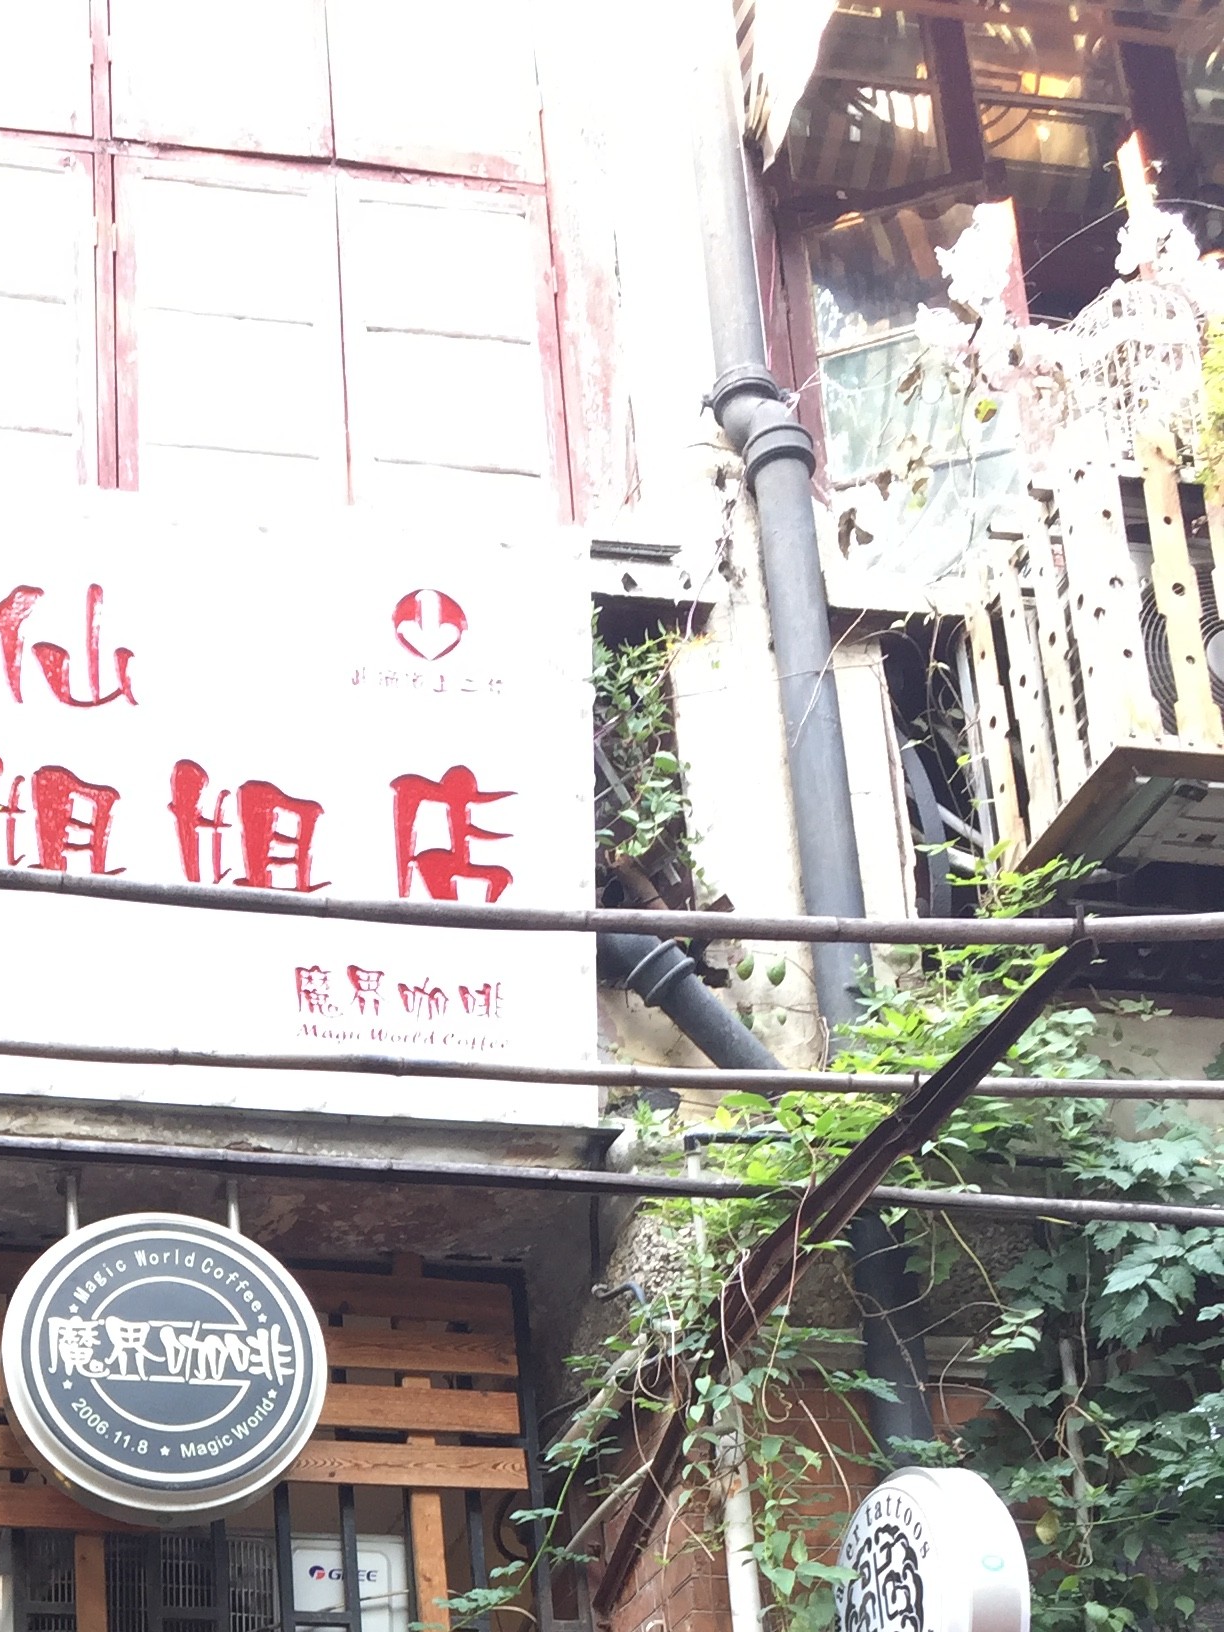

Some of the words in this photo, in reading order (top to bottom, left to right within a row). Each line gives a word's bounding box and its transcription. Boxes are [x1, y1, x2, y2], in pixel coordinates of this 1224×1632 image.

[294, 964, 505, 1022] 魔界咖啡
[73, 1260, 128, 1305] Magic
[134, 1248, 195, 1269] World
[201, 1256, 263, 1313] Coffee
[46, 1315, 295, 1387] 魔界咖啡
[70, 1397, 150, 1456] 2006.11.8
[180, 1432, 234, 1460] Magic
[232, 1397, 275, 1444] World
[328, 1567, 379, 1583] GEE
